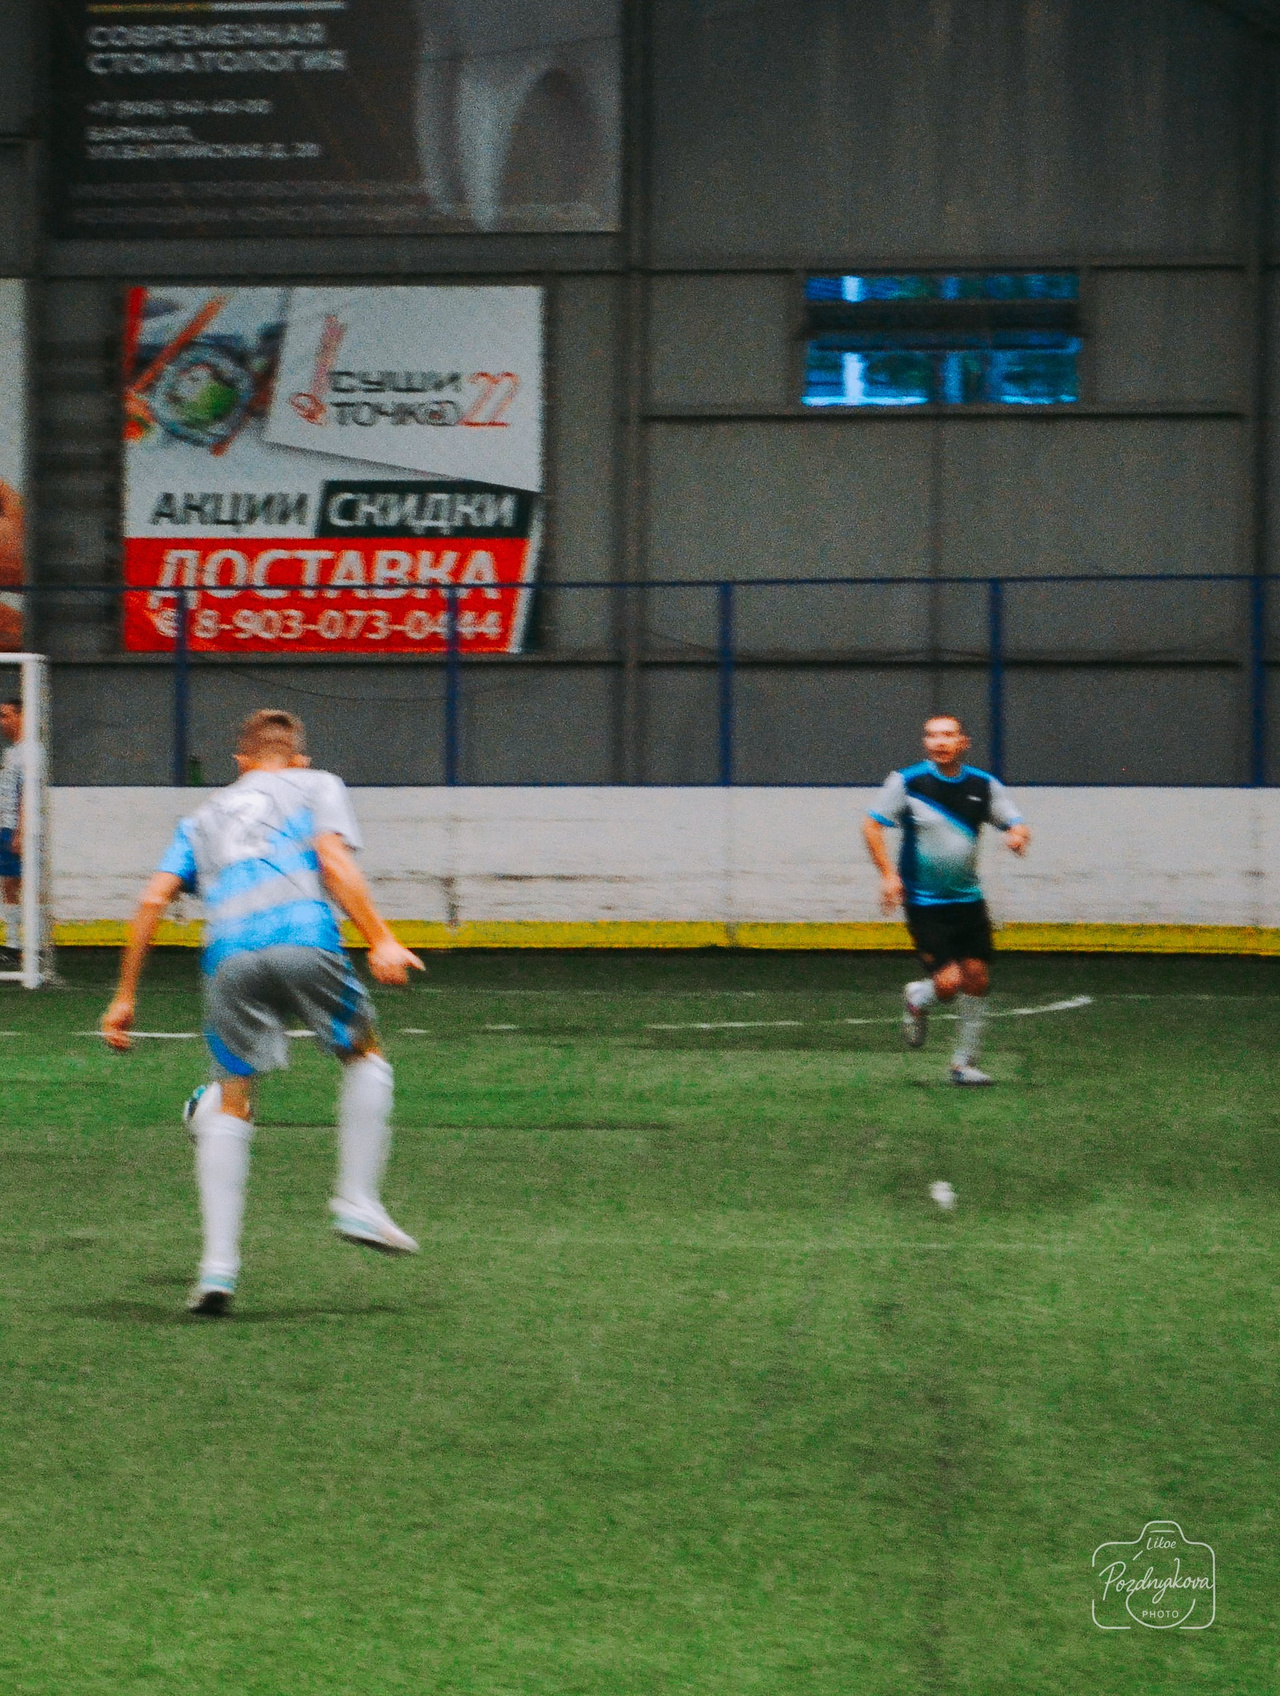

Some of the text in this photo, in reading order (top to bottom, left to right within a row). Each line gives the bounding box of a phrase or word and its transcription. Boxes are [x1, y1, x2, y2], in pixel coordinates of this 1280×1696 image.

[457, 371, 518, 427] 22
[150, 492, 307, 533] АКЦИИ
[328, 493, 518, 535] СКИДКИ
[150, 548, 502, 608] ДОСТАВКА
